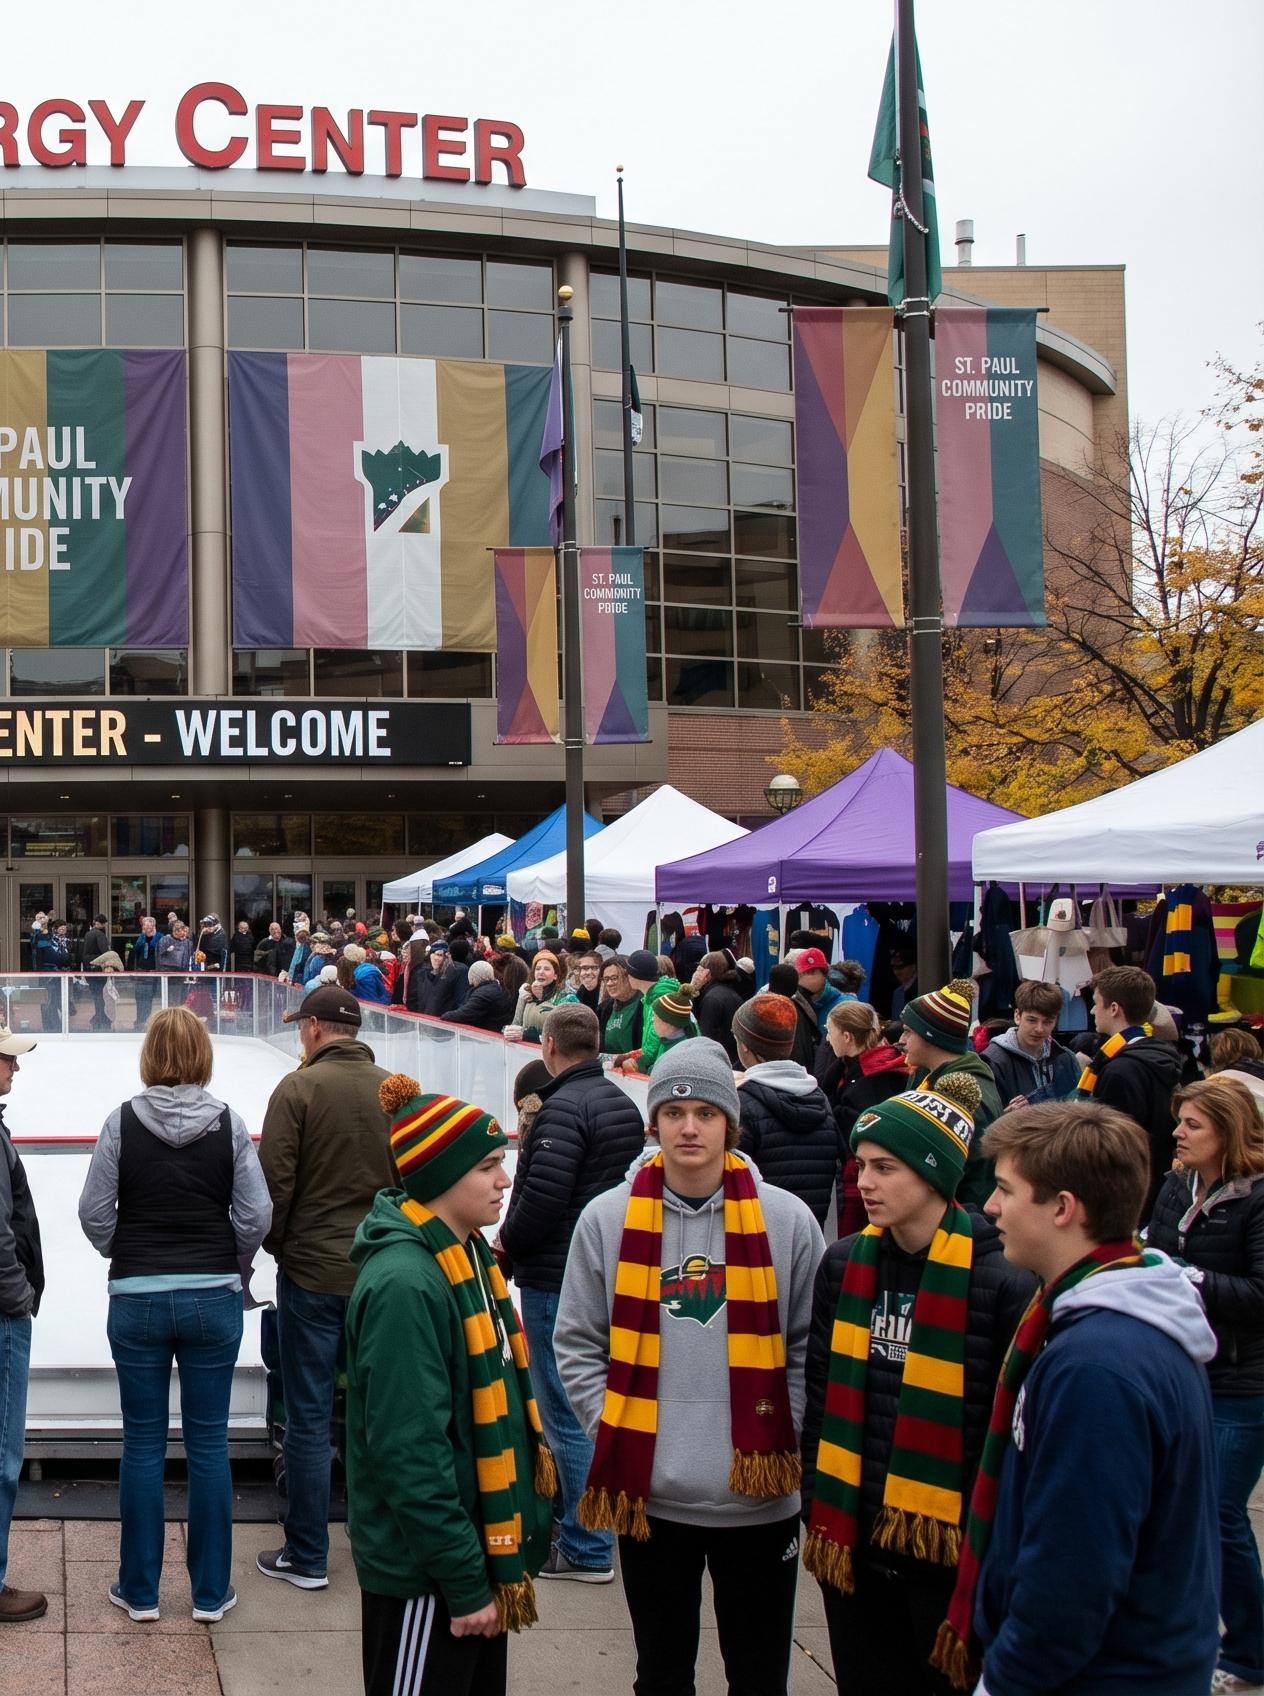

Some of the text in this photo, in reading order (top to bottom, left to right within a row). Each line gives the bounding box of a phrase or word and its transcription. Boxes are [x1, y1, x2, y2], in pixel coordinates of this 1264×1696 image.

[175, 81, 528, 189] CENTER
[954, 357, 1020, 374] ST. PAUL
[941, 379, 1034, 397] COMMUNITY
[965, 402, 1013, 420] PRIDE
[592, 573, 634, 585] ST. PAUL
[175, 709, 392, 758] WELCOME
